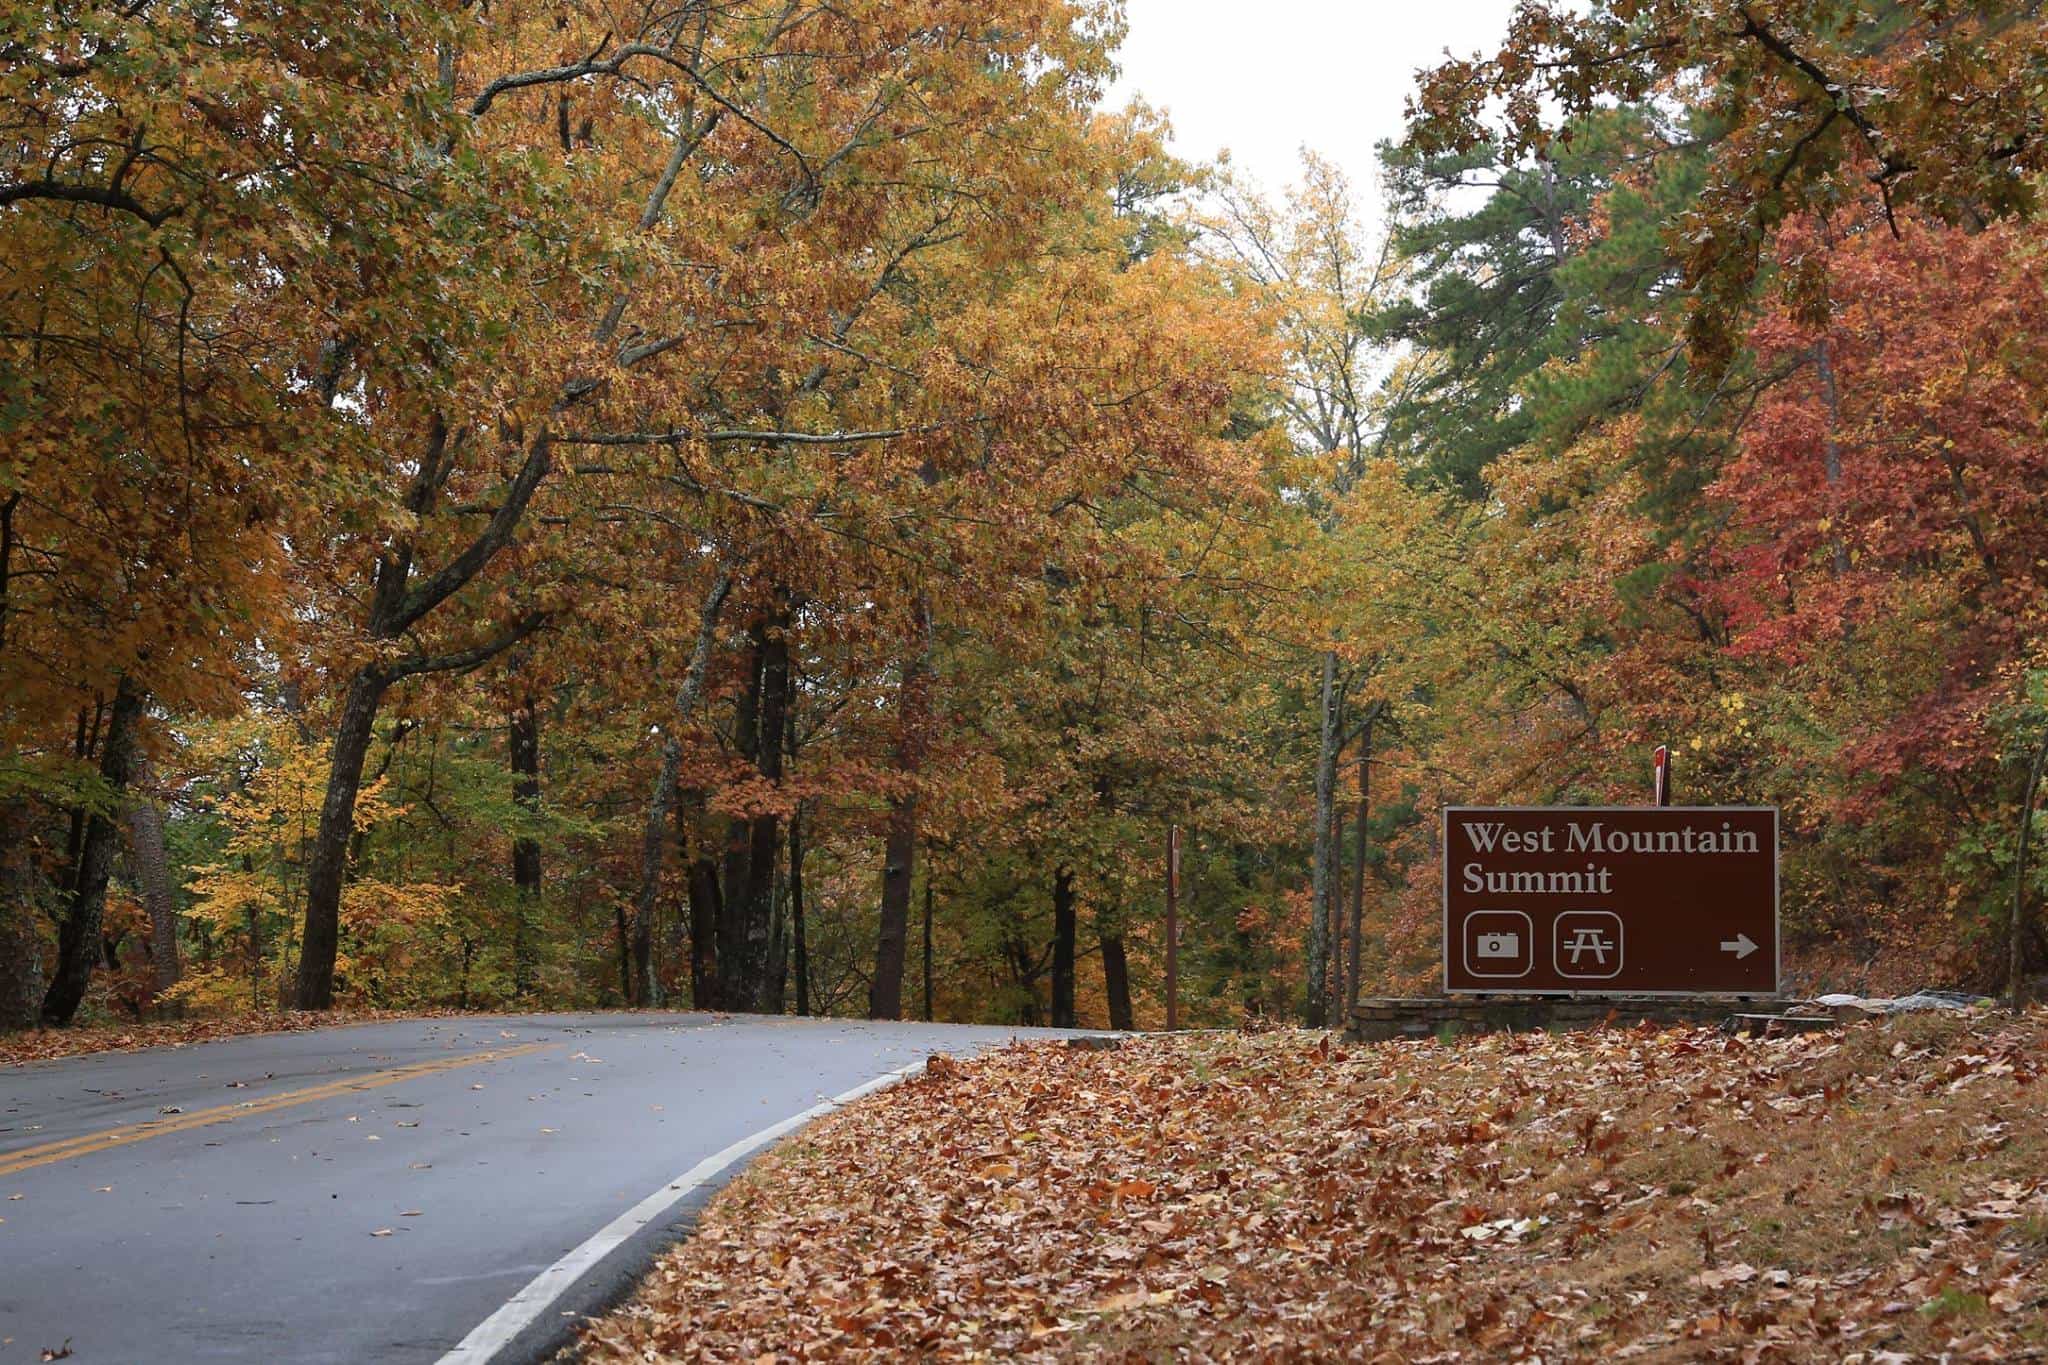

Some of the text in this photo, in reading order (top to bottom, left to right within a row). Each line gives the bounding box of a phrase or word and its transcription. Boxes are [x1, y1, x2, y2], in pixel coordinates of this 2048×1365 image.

[1462, 822, 1760, 853] West Mountain
[1462, 863, 1613, 894] Summit
